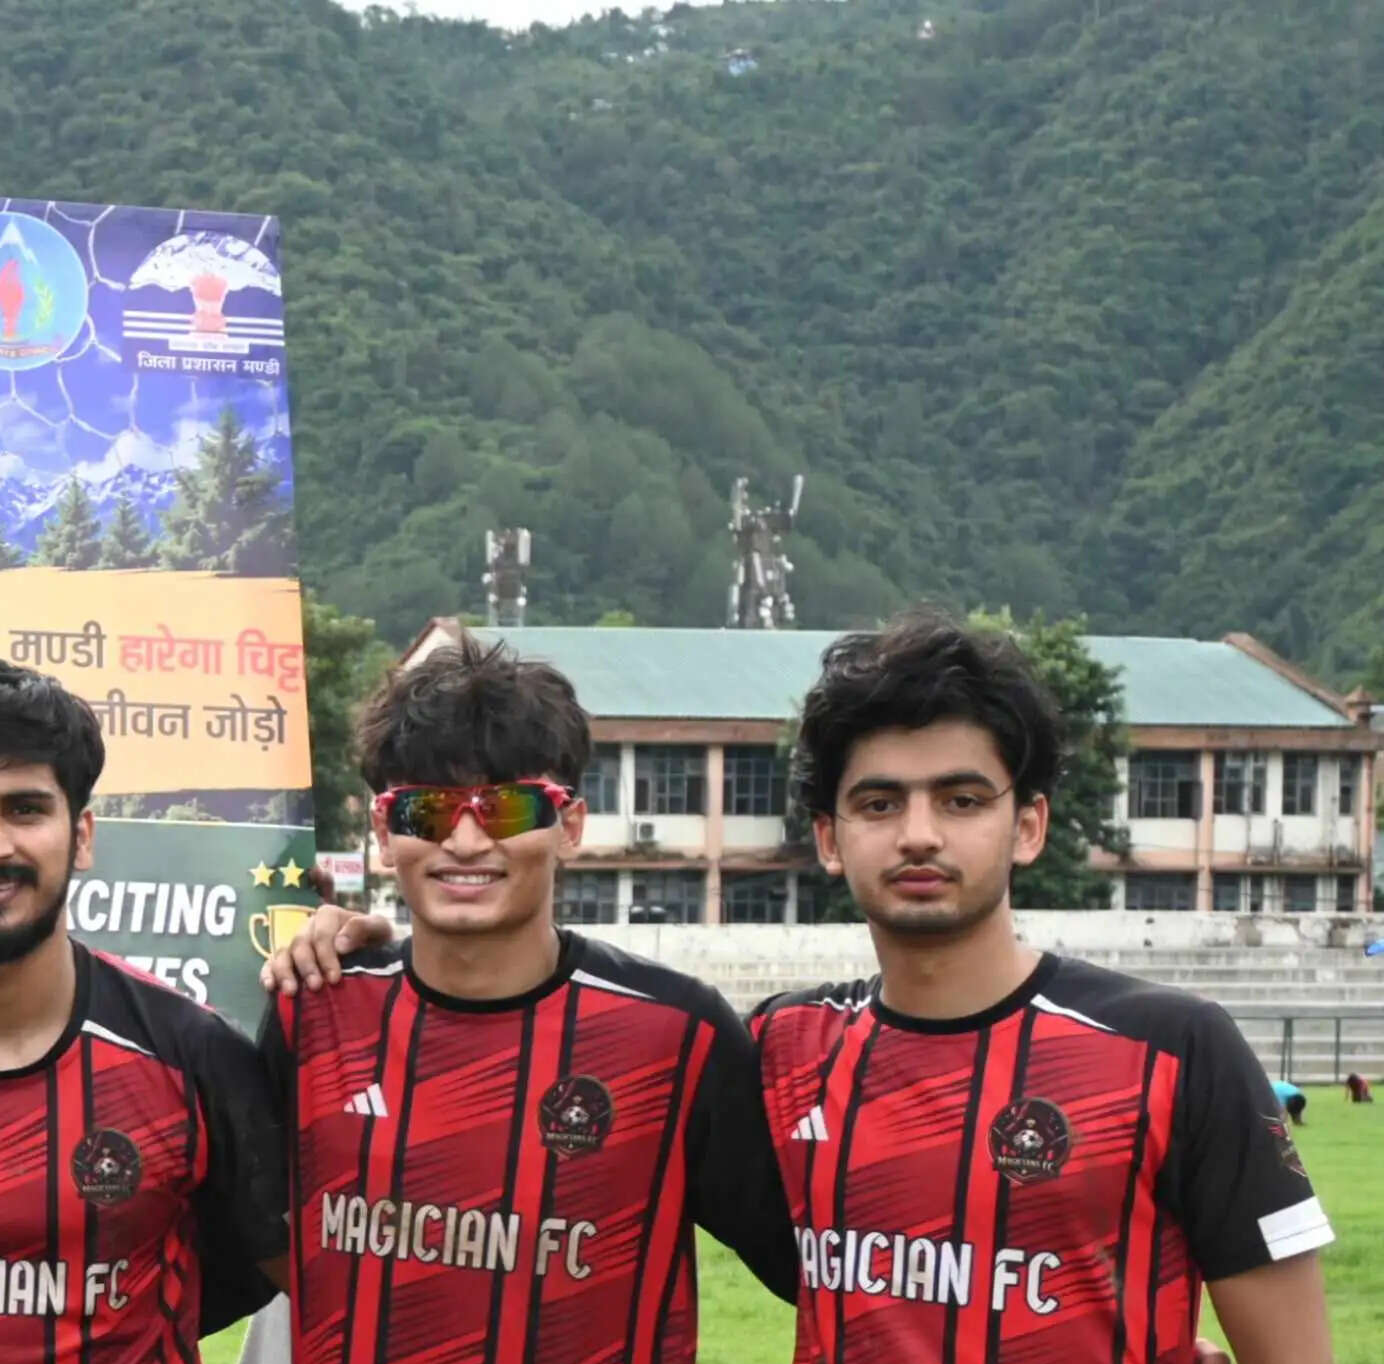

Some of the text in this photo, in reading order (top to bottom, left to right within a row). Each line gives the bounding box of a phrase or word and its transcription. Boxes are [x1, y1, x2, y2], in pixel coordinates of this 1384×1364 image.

[9, 620, 106, 668] मण्डी
[118, 623, 224, 675] हारेगा
[66, 879, 237, 936] XCITING
[321, 1192, 597, 1279] MAGICIAN FC
[85, 1259, 130, 1316] FC
[992, 1247, 1061, 1315] FC
